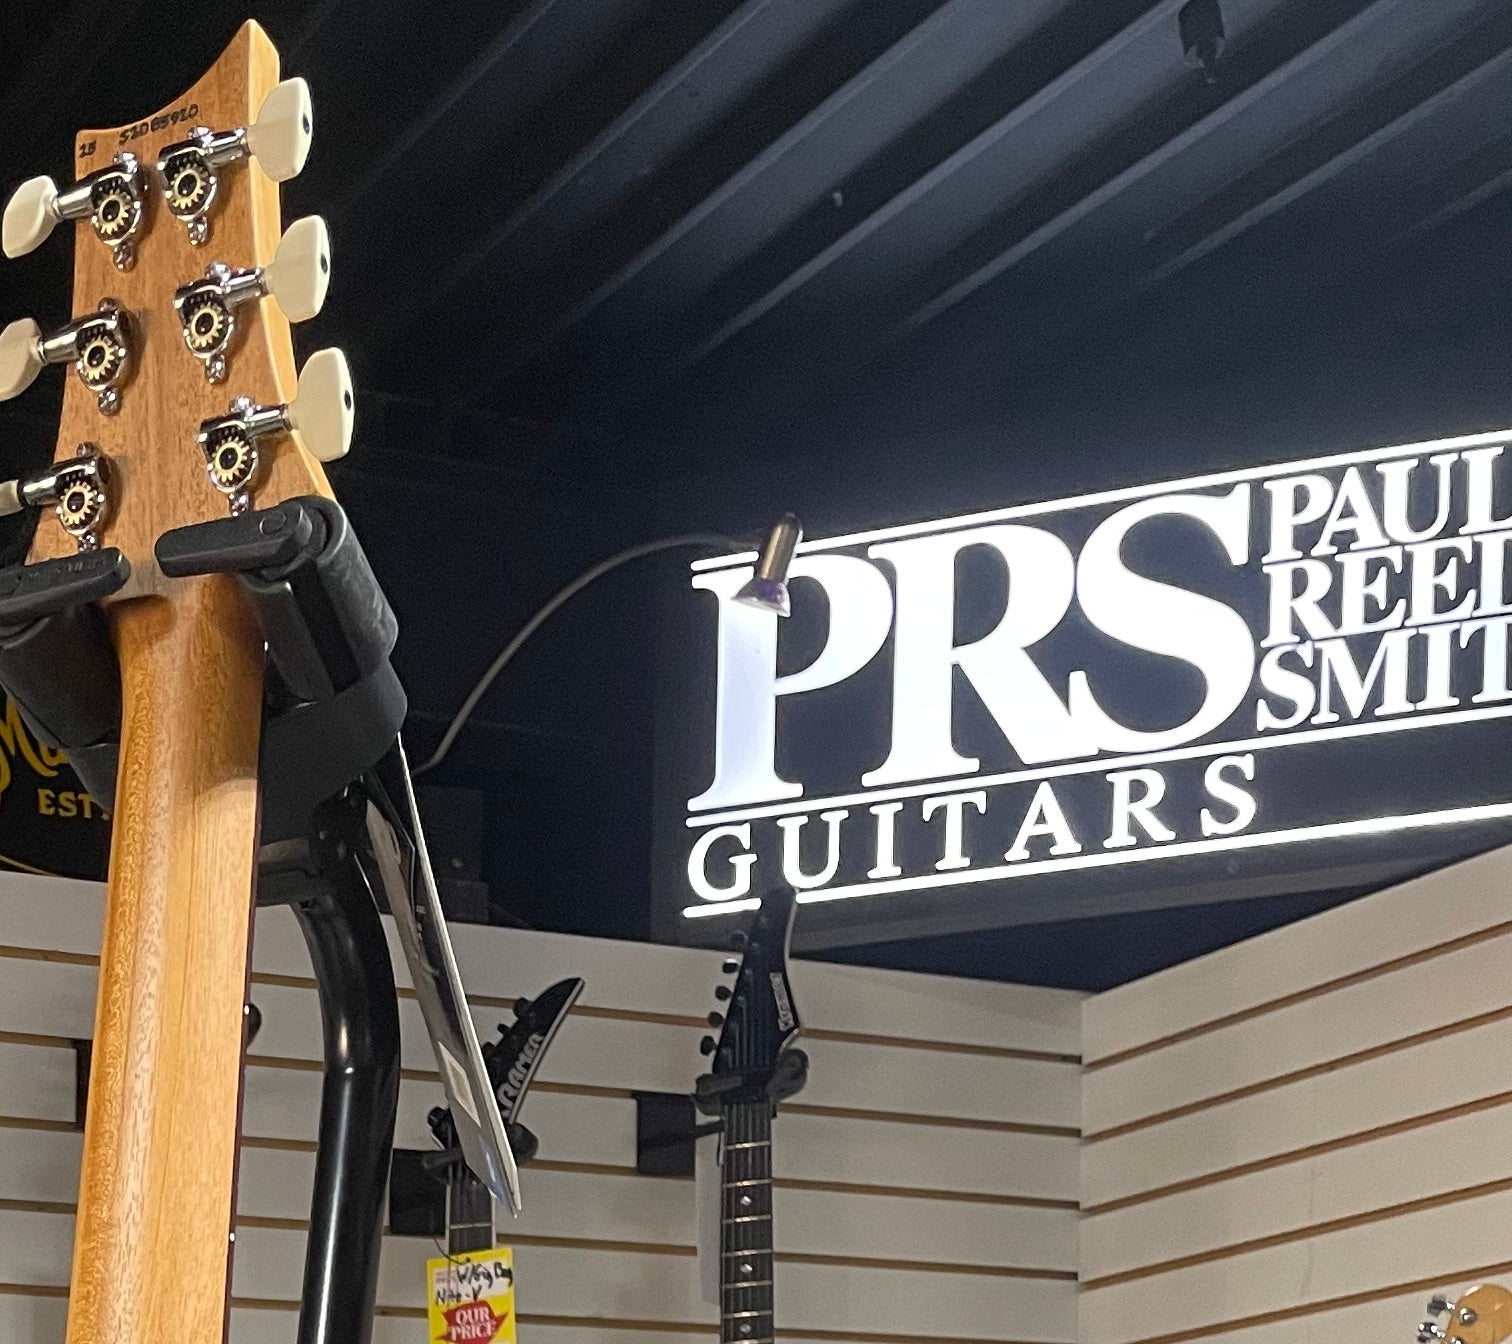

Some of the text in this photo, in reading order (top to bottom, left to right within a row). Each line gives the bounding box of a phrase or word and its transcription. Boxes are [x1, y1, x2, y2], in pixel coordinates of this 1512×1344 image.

[1261, 446, 1512, 564] PAUL
[687, 482, 1256, 811] PRS
[687, 754, 1257, 904] GUITARS
[497, 1032, 545, 1118] RAMER
[450, 1320, 498, 1341] PRICE
[455, 1306, 491, 1324] OUR
